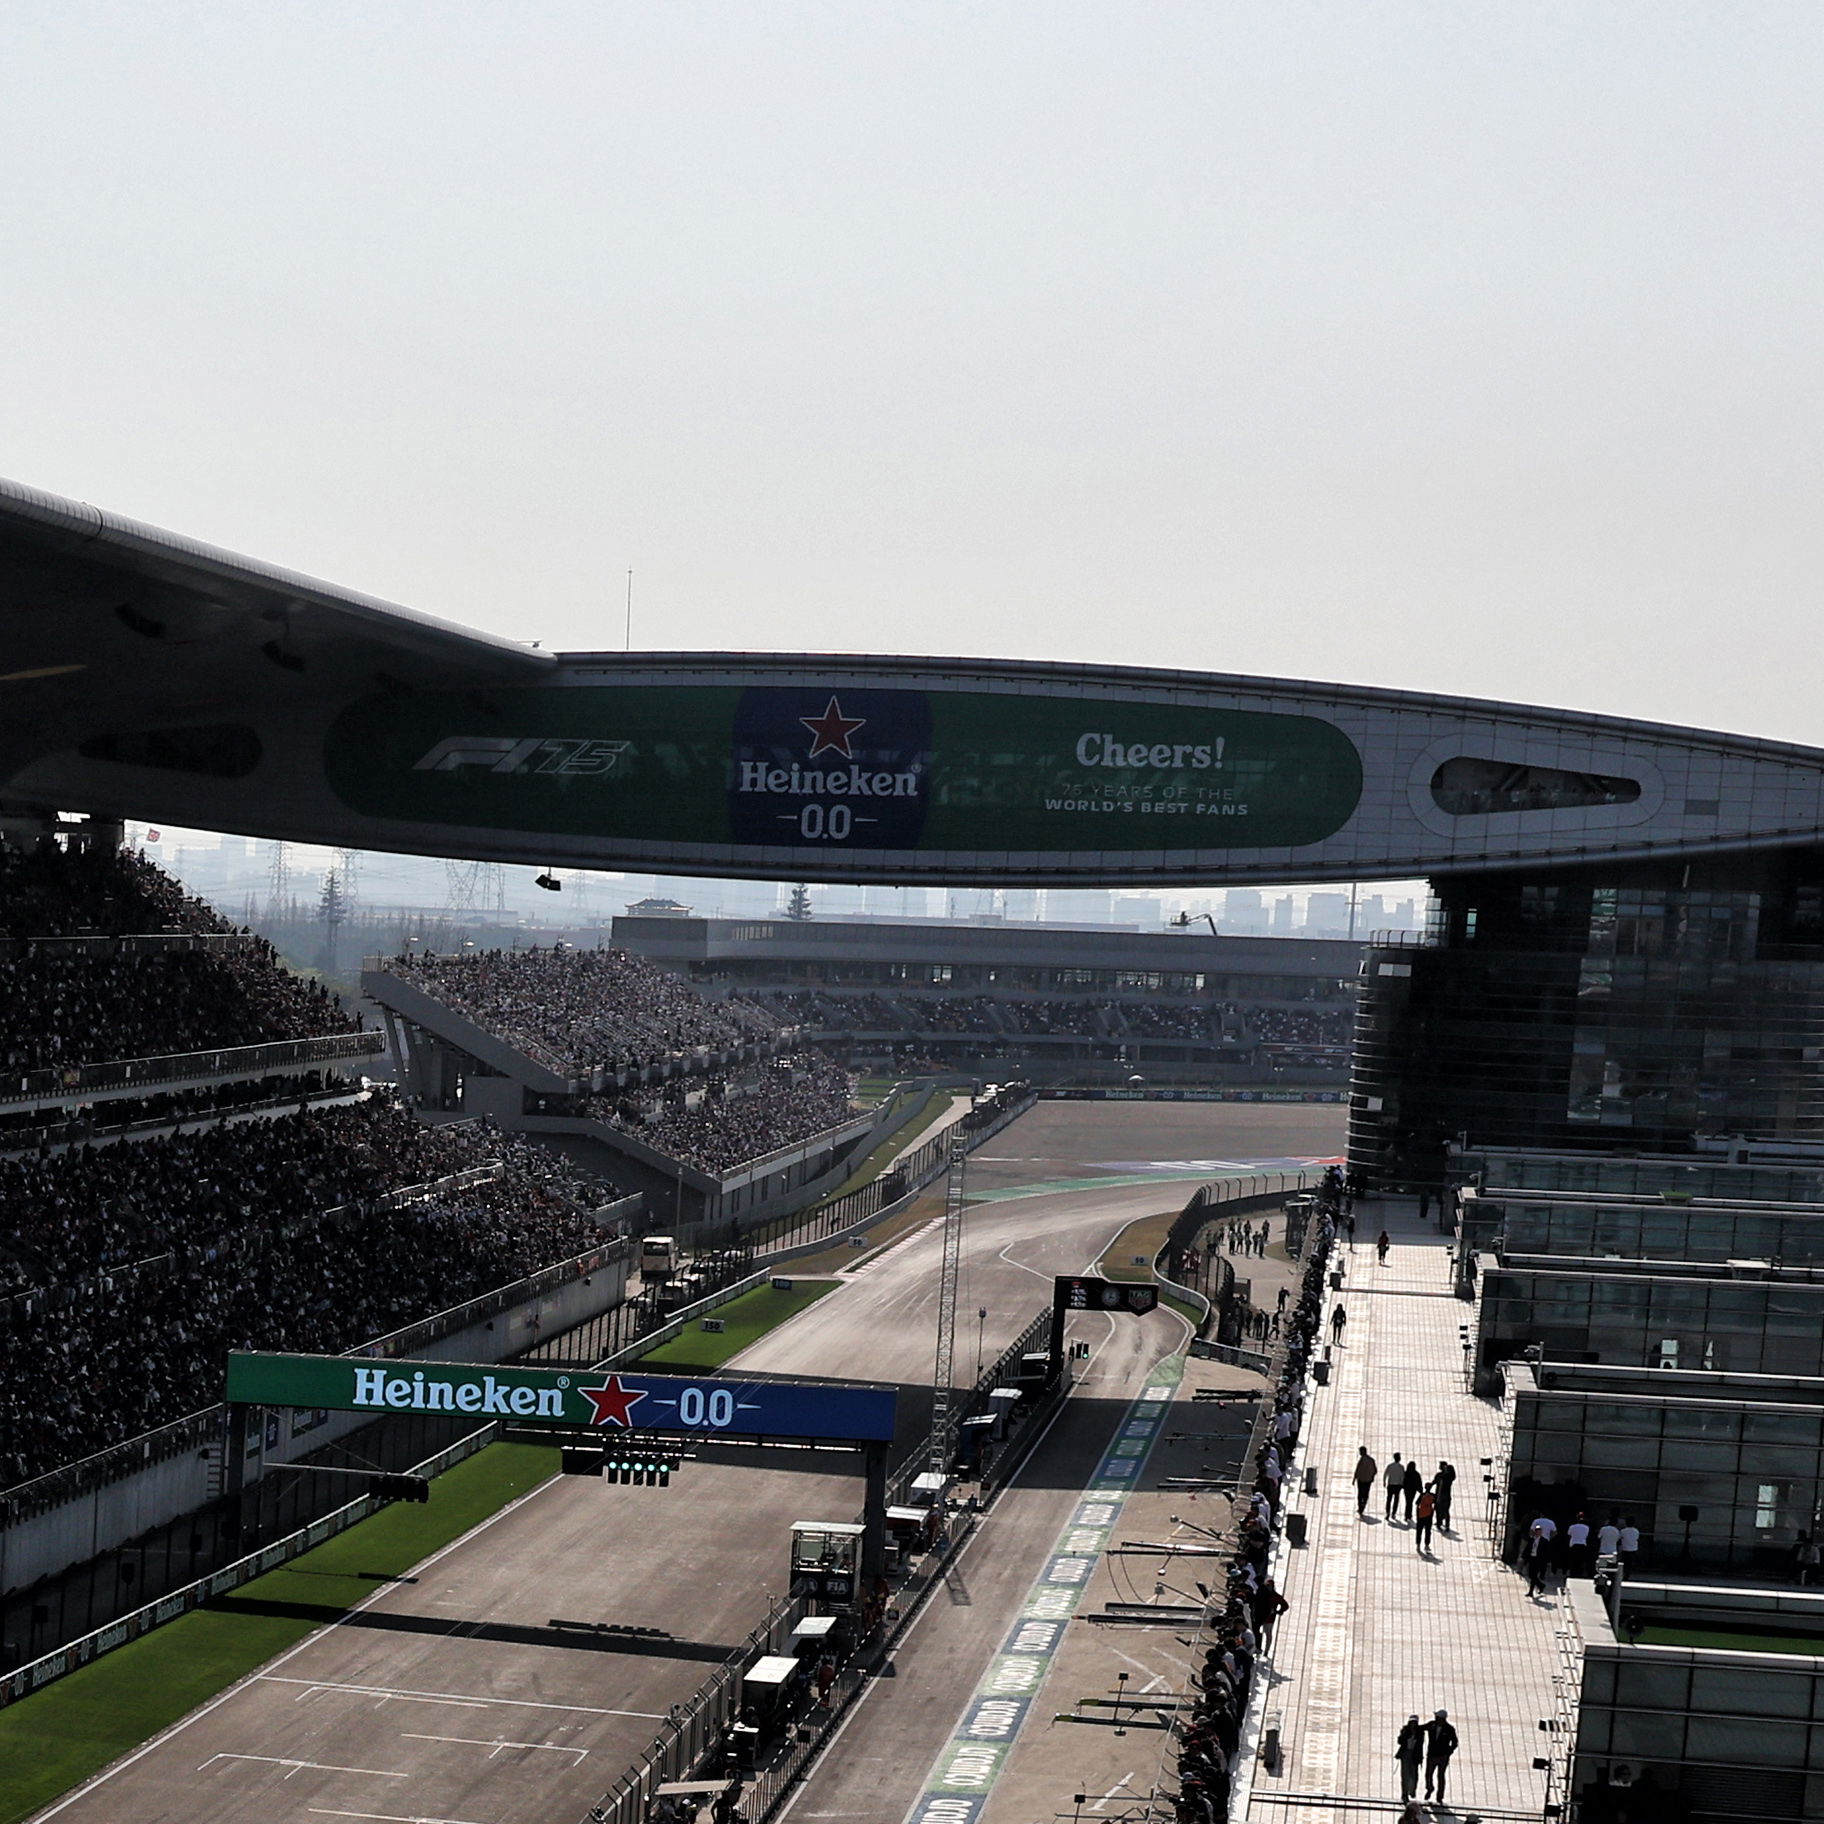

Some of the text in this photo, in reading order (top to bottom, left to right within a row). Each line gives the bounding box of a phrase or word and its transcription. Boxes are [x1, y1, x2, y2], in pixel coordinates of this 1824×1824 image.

[1076, 733, 1225, 769] Cheers!
[739, 761, 918, 797] Heineken
[1061, 784, 1234, 800] 75 YEARS OF THE
[1045, 799, 1249, 816] WORLD'S BEST FANS
[705, 1321, 720, 1330] 150
[353, 1368, 565, 1417] Heineken
[826, 1581, 848, 1594] FIA
[968, 1699, 1021, 1736] aramco
[942, 1747, 998, 1786] aramco
